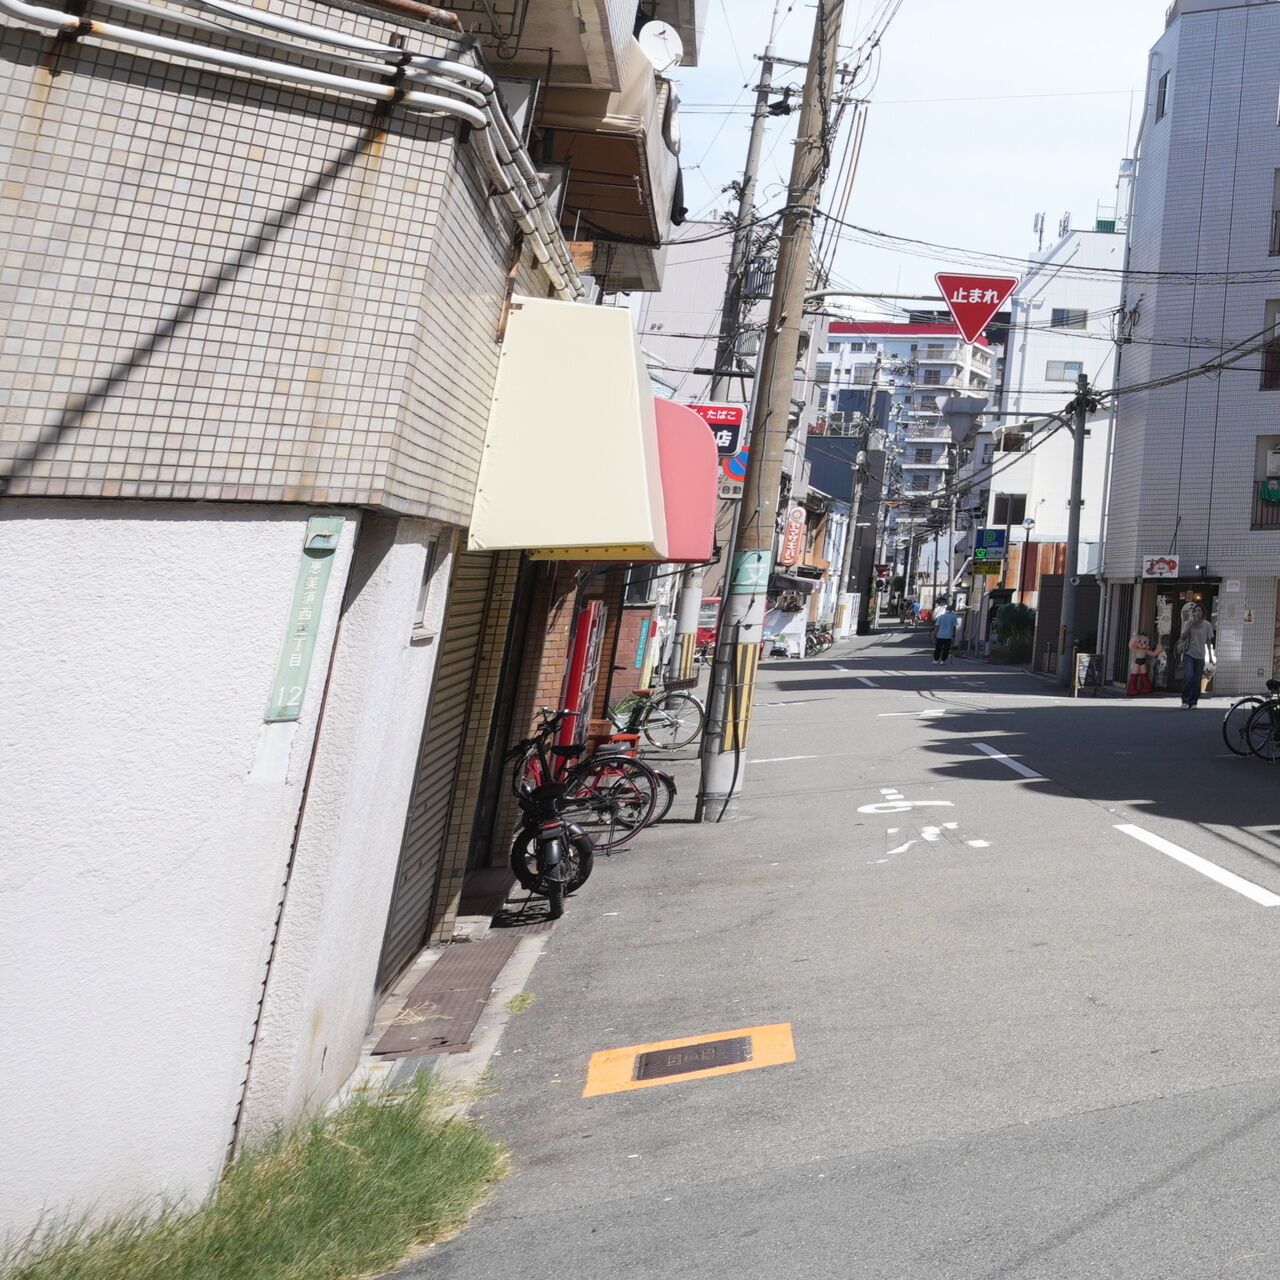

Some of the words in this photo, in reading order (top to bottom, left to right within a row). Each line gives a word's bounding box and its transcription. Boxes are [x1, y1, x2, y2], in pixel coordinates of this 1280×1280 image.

[950, 287, 1000, 304] 止まれ
[738, 563, 768, 585] 文
[278, 687, 303, 707] 12
